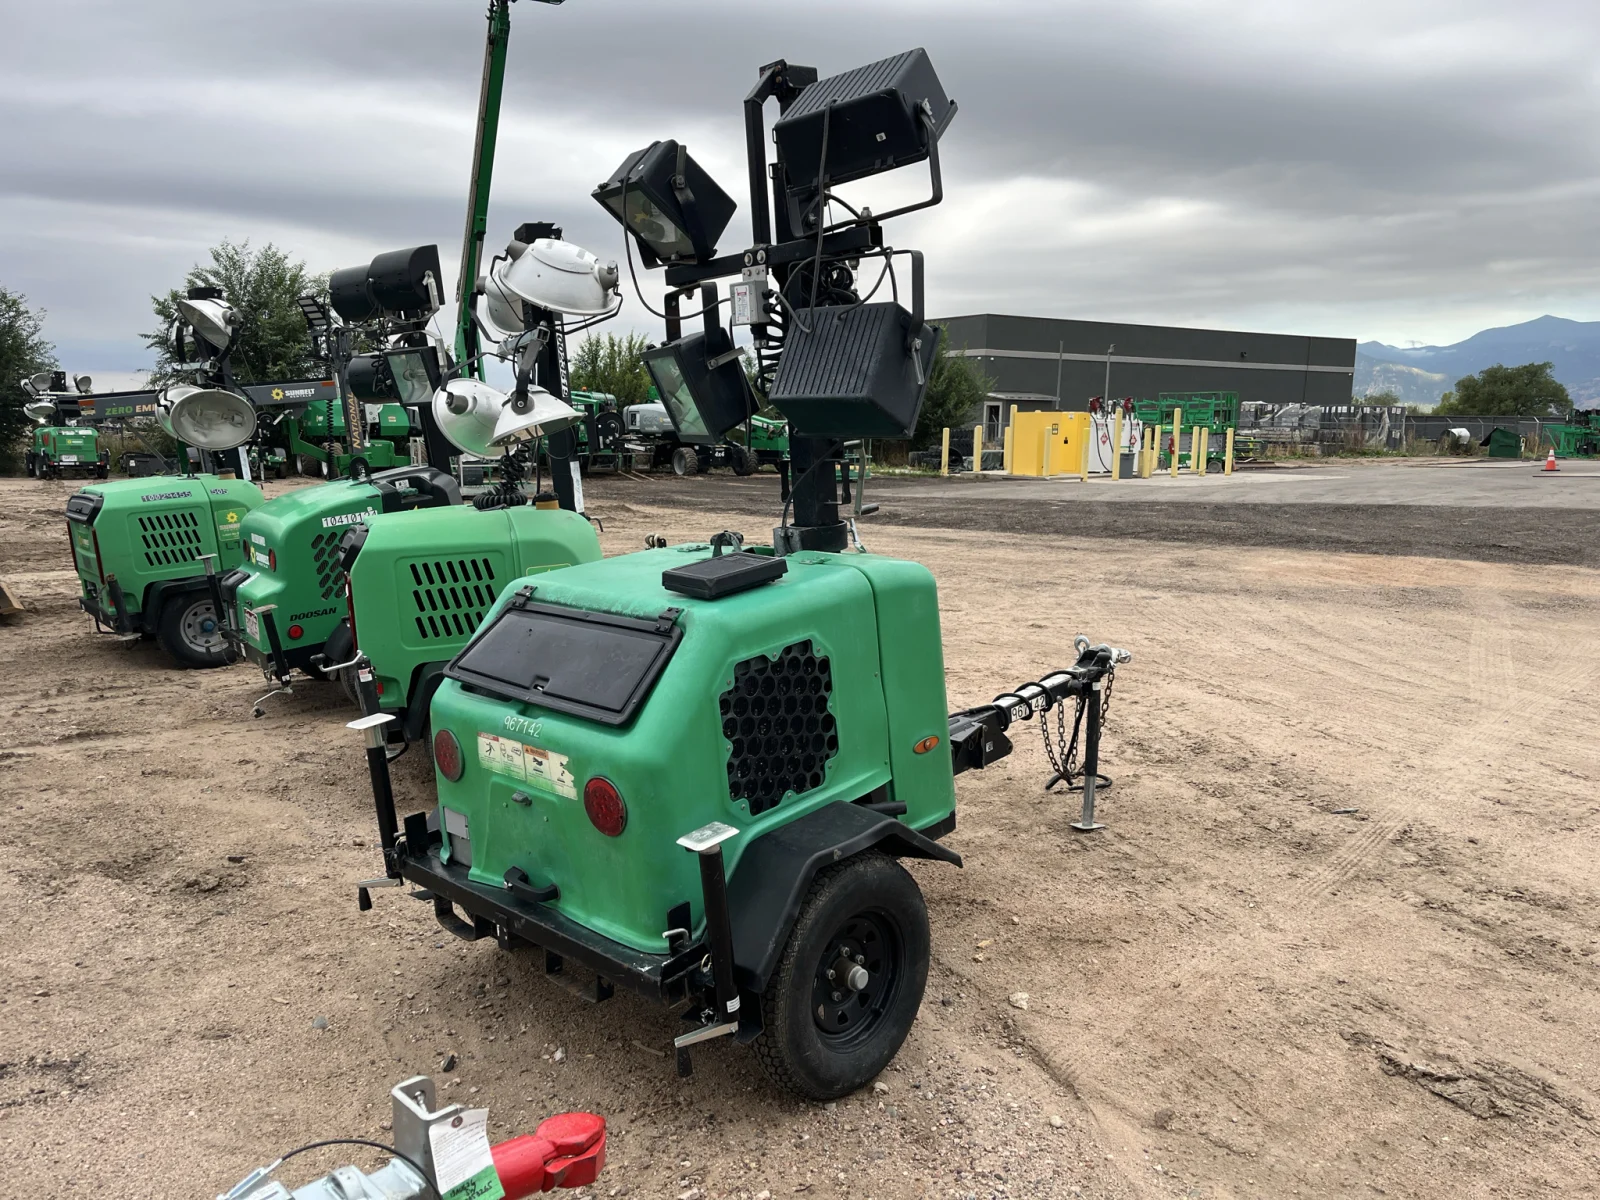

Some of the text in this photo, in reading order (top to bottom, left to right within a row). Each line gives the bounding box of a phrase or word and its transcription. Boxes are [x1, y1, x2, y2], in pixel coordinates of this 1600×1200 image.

[284, 388, 315, 397] SUNBELT
[105, 405, 133, 416] ZERO
[347, 392, 361, 449] NATIONAL
[290, 607, 337, 622] DOOSAN
[504, 715, 543, 738] 967142
